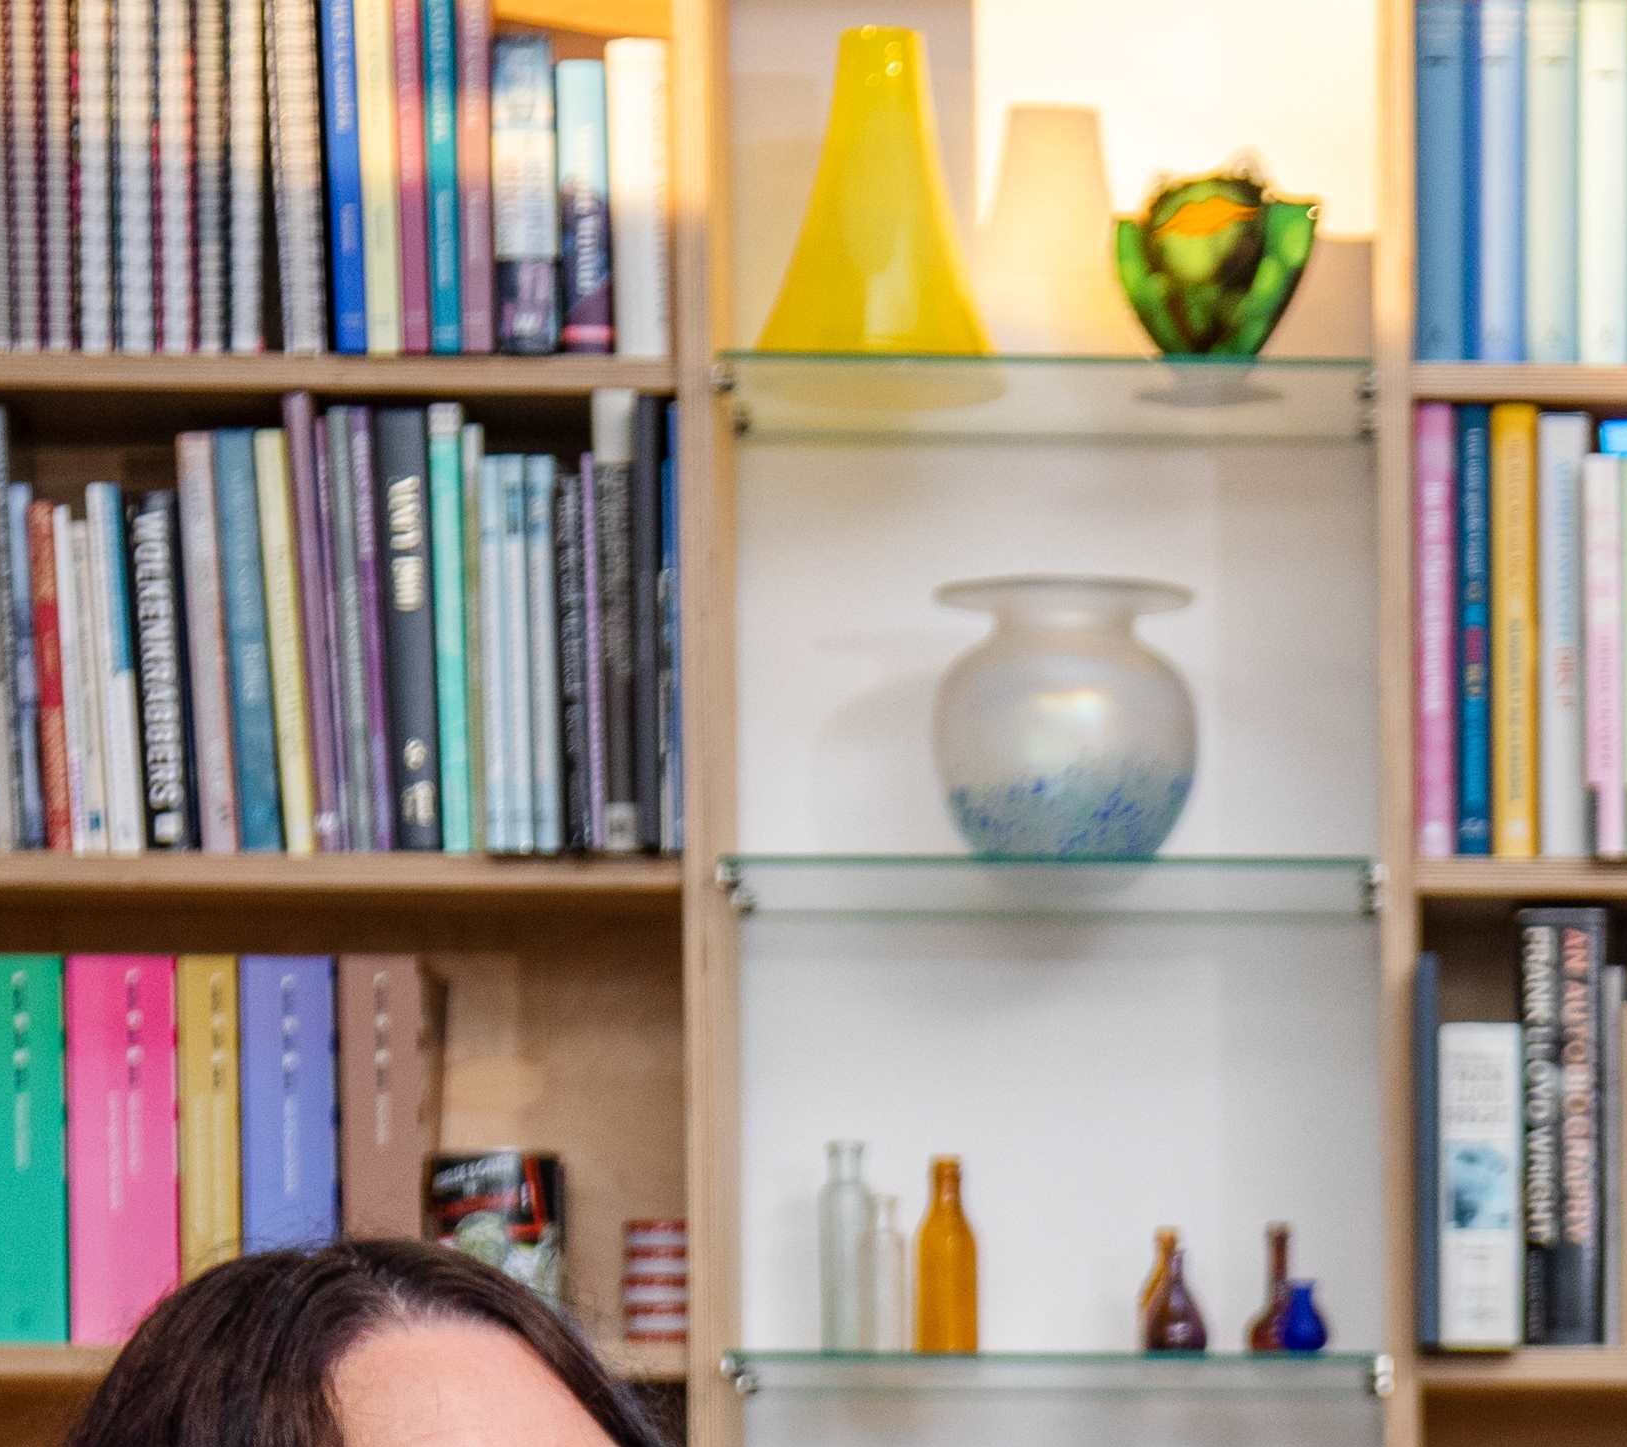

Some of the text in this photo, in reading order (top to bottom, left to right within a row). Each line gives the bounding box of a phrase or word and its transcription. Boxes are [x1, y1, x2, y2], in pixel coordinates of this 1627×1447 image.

[125, 507, 188, 810] WOLKENKRABBERS
[1524, 925, 1555, 1245] FRANK LLOYD WRIGHT
[1562, 926, 1593, 1245] AN AUTOBIOGRAPHY
